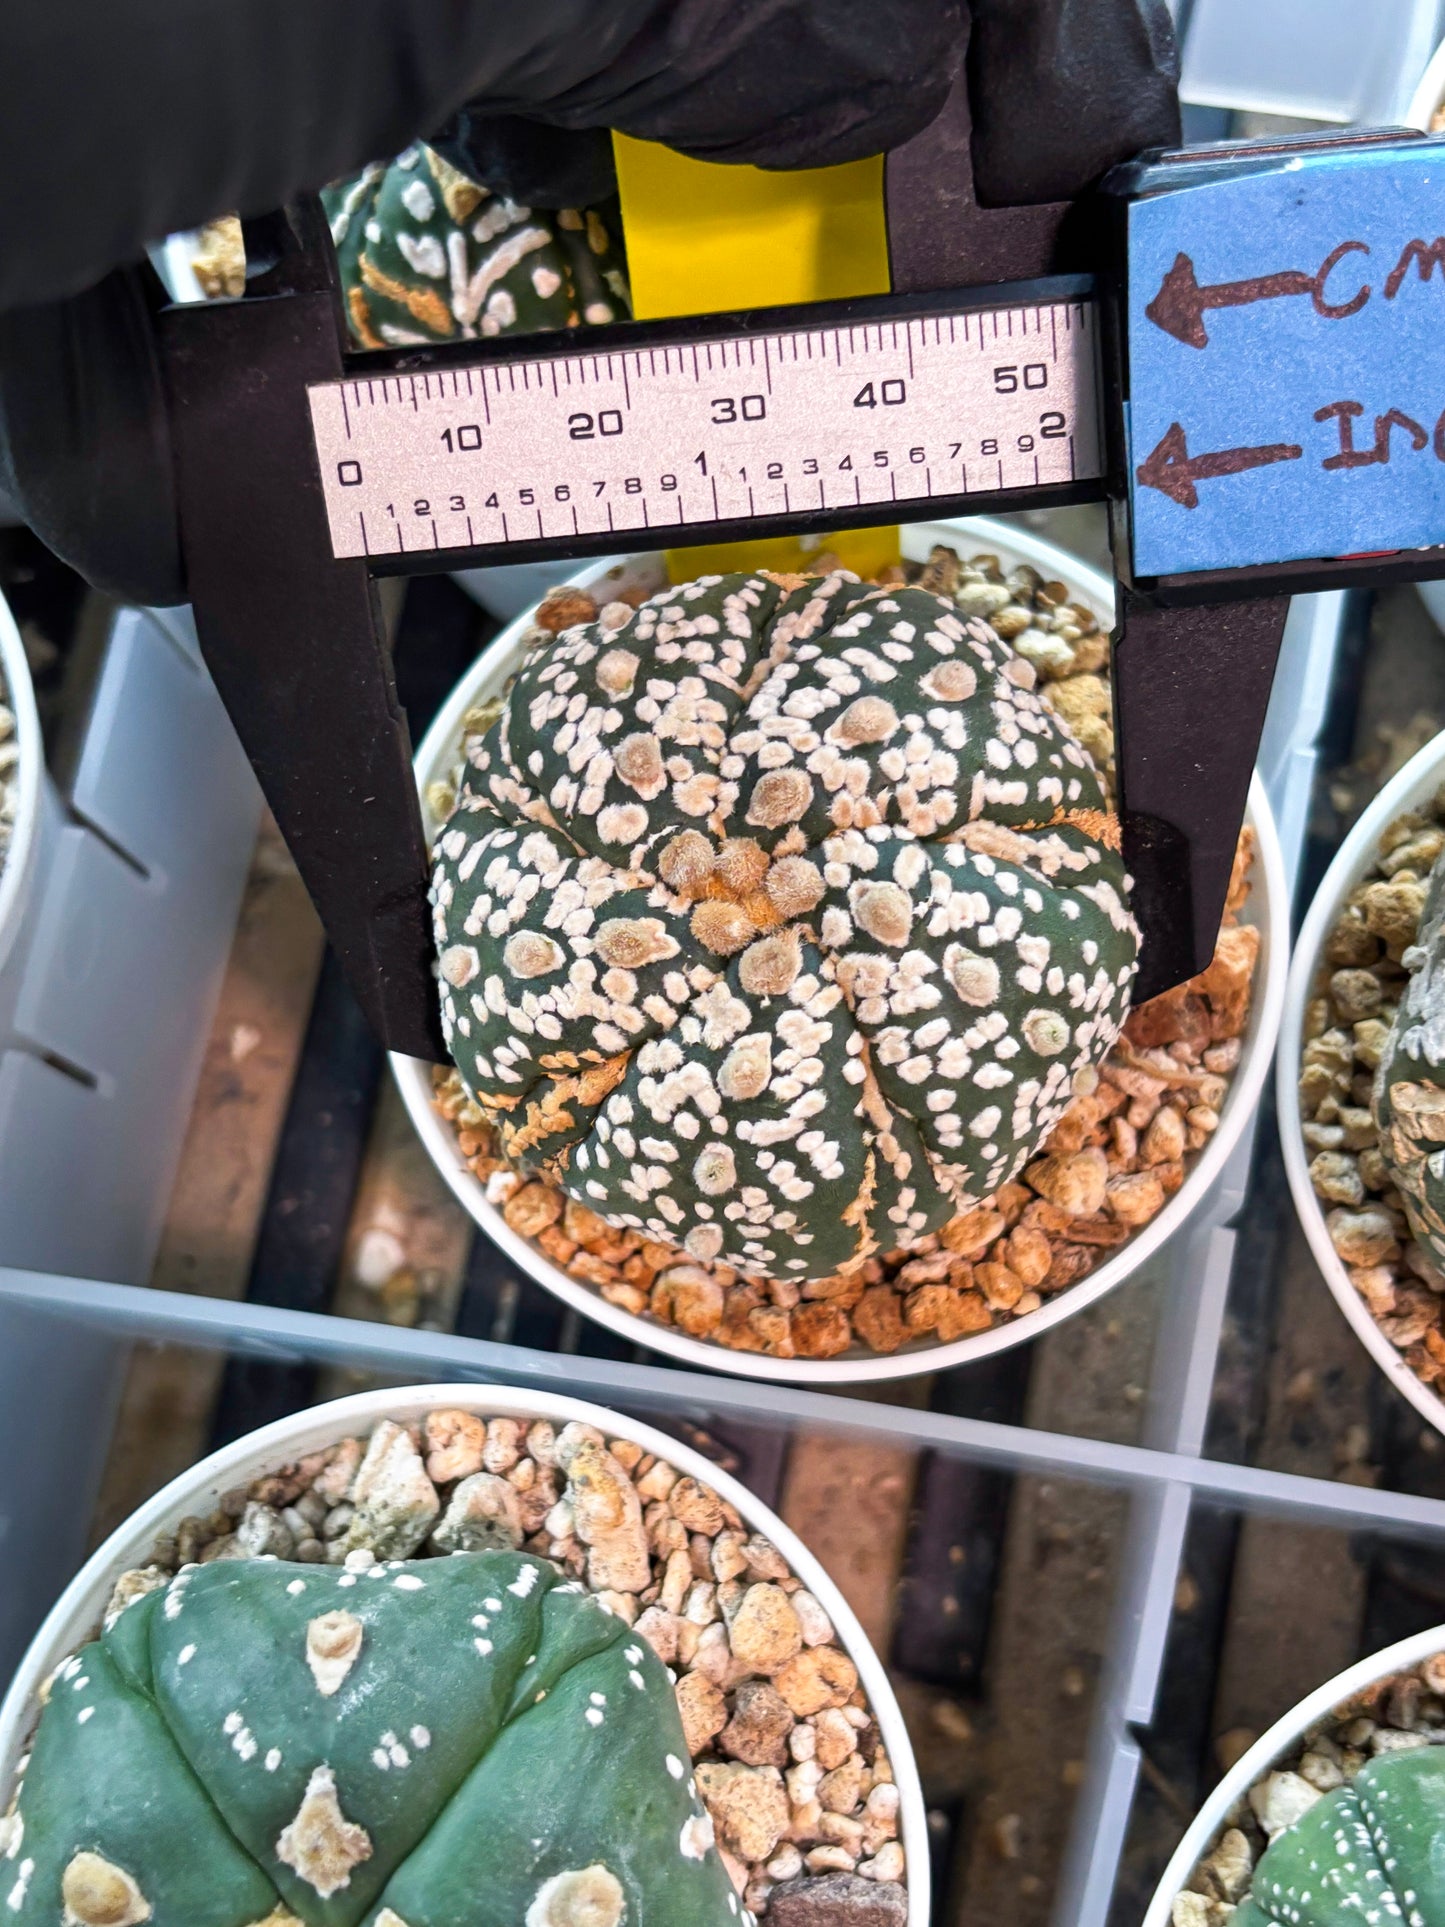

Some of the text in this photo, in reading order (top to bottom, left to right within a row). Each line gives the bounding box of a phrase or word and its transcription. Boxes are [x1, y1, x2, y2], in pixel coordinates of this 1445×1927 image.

[337, 363, 1047, 486] 0 10 20 30 40 50
[385, 411, 1067, 519] 1 2 3 4 5 6 7 8 9 1 1 2 3 4 5 6 7 8 9 2
